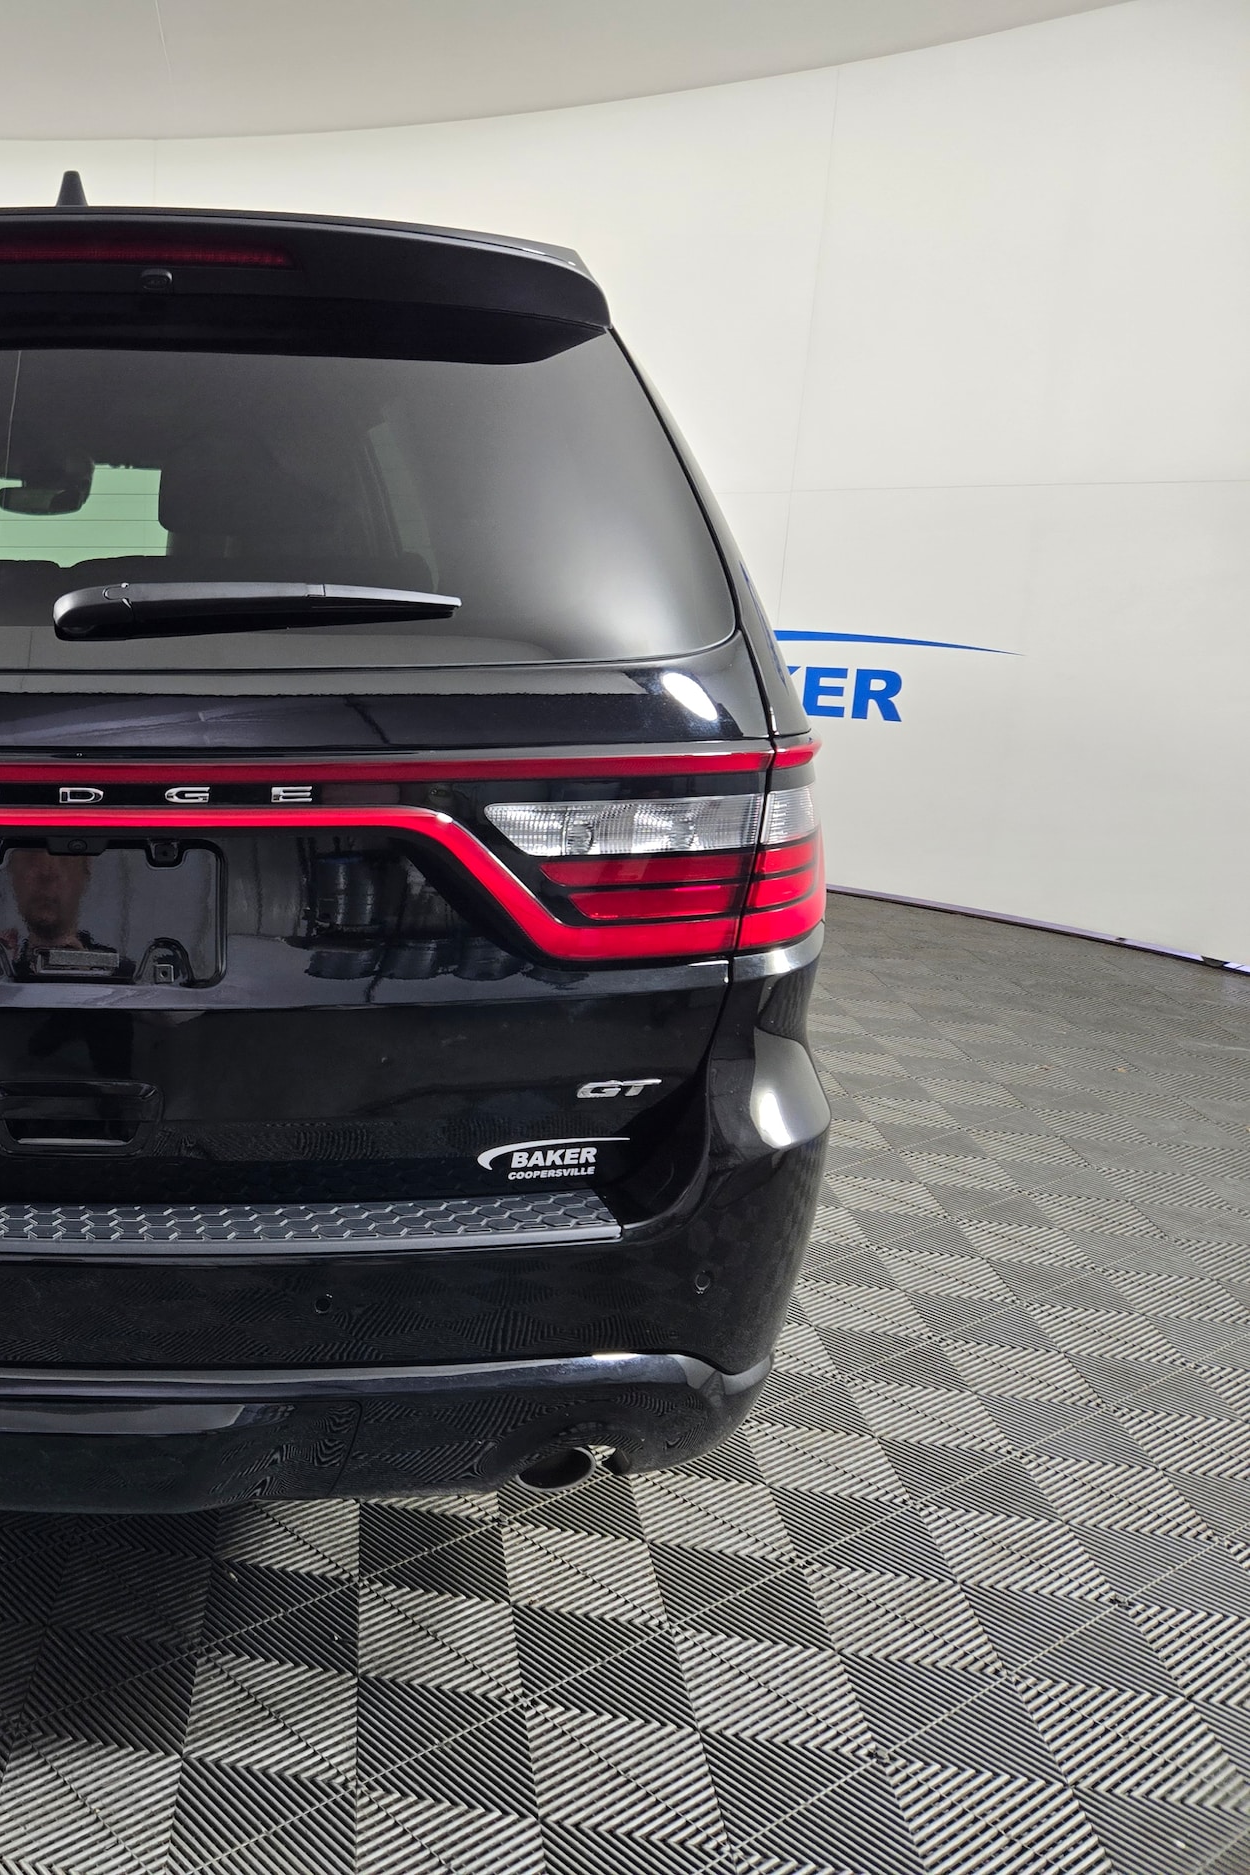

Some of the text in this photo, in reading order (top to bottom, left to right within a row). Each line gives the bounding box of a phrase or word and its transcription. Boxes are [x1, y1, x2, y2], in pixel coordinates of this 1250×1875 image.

[787, 666, 903, 722] ER
[576, 1079, 662, 1098] GT
[511, 1147, 597, 1168] BAKER
[508, 1166, 596, 1180] COOPERSVILLE
